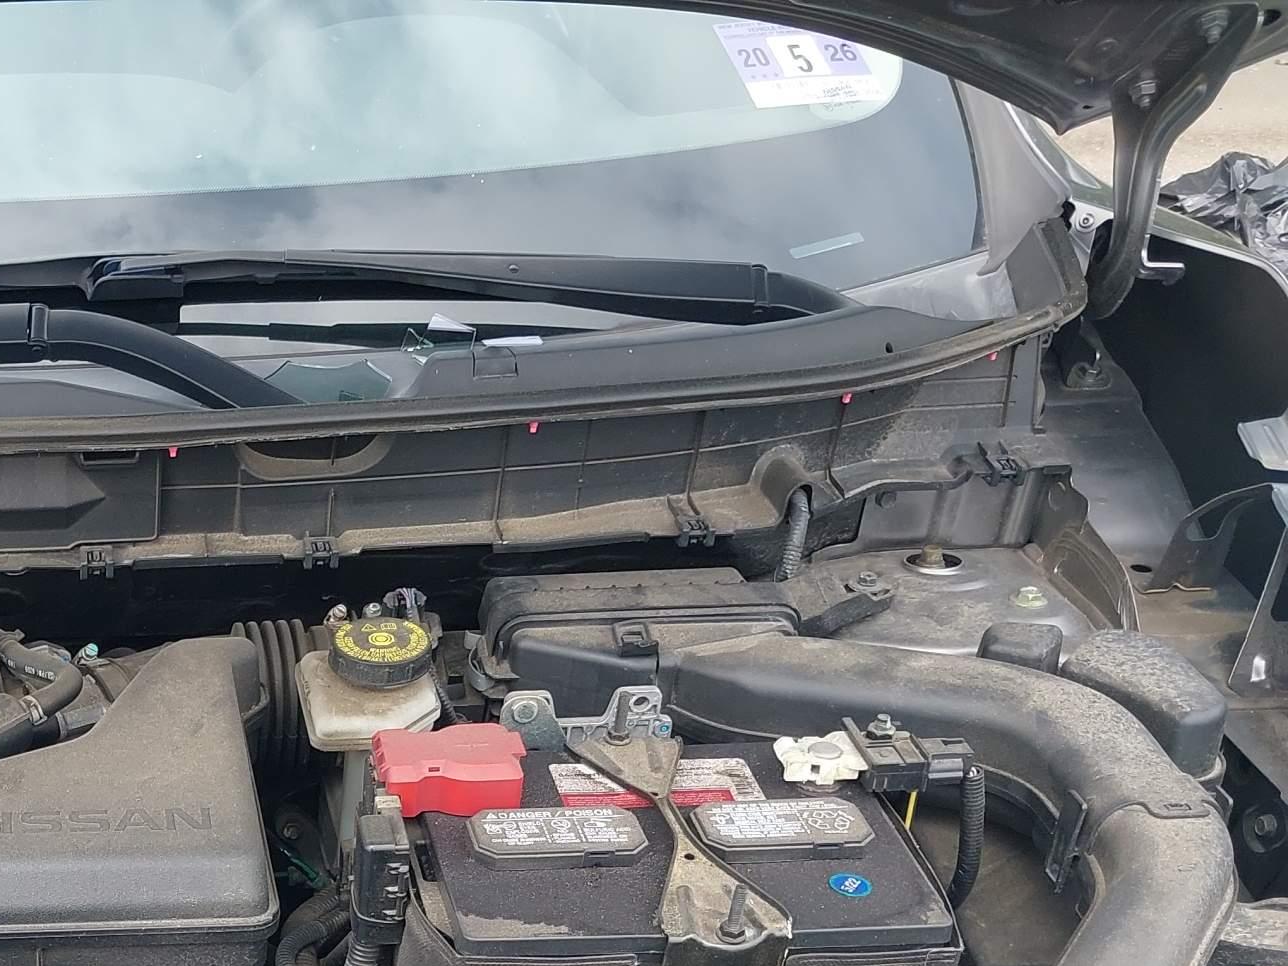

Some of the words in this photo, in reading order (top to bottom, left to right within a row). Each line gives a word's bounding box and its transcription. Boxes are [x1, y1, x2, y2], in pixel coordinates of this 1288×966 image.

[738, 47, 770, 68] 20
[787, 44, 813, 73] 5
[824, 43, 858, 62] 26
[498, 811, 552, 819] DANGER
[565, 808, 613, 817] POISON
